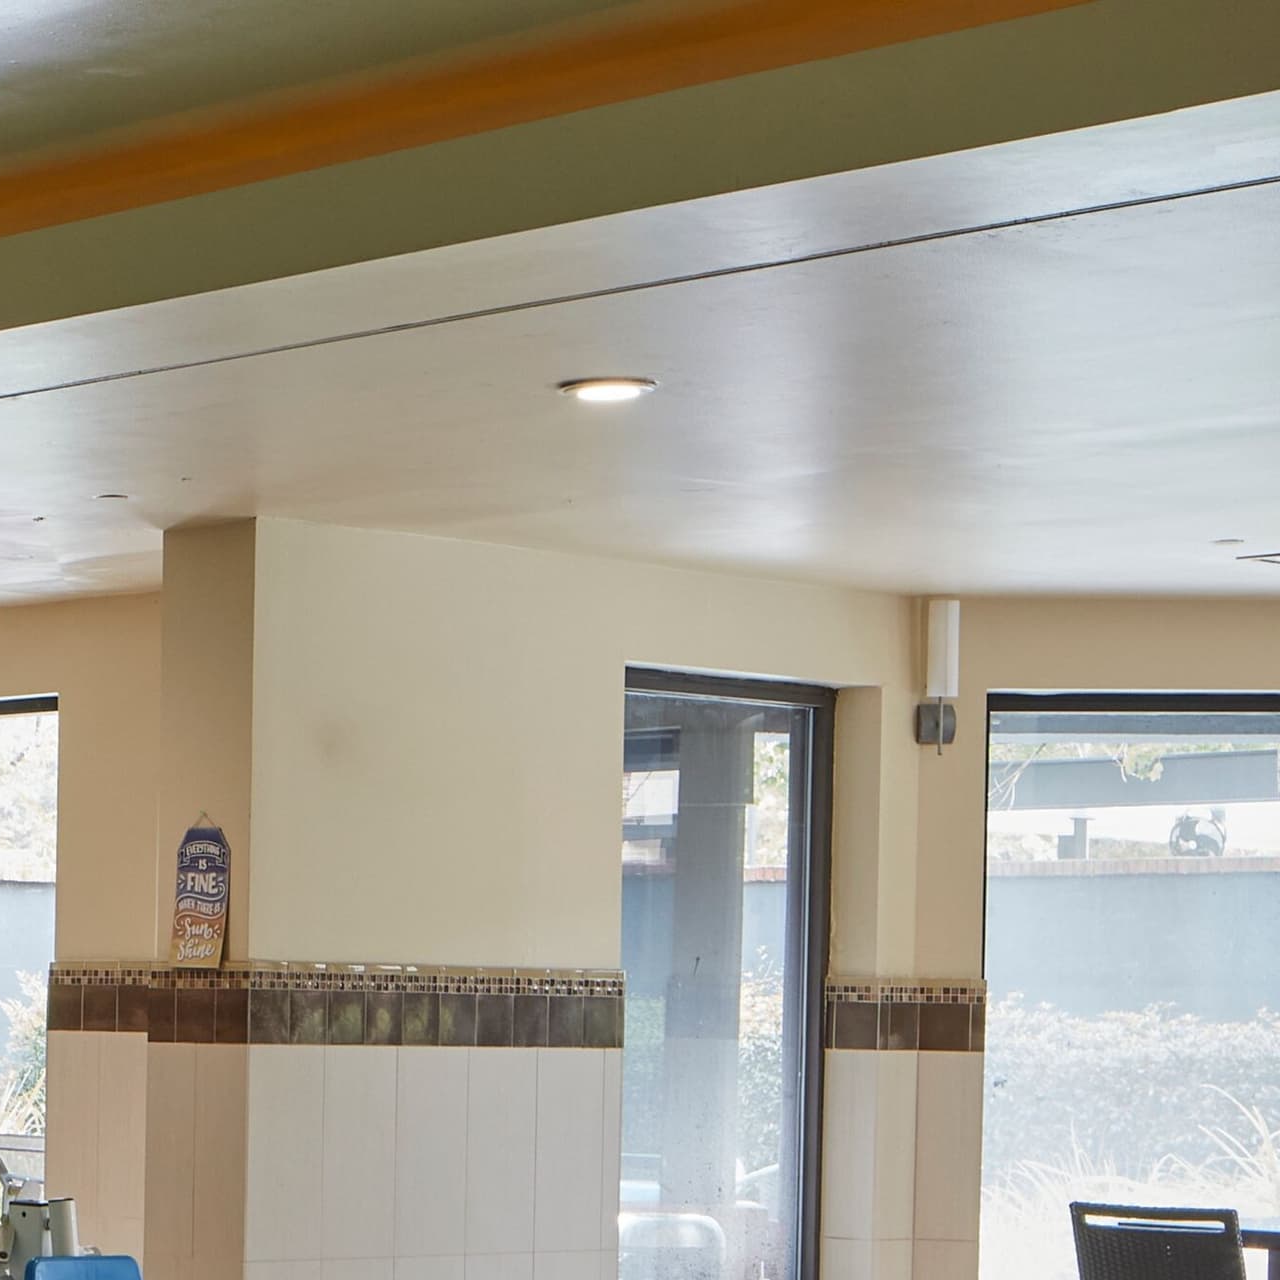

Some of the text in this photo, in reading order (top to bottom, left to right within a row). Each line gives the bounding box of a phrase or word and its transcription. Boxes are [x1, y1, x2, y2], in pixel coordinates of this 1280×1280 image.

[198, 858, 208, 870] IS
[186, 872, 218, 894] FINE
[184, 918, 213, 940] Sun
